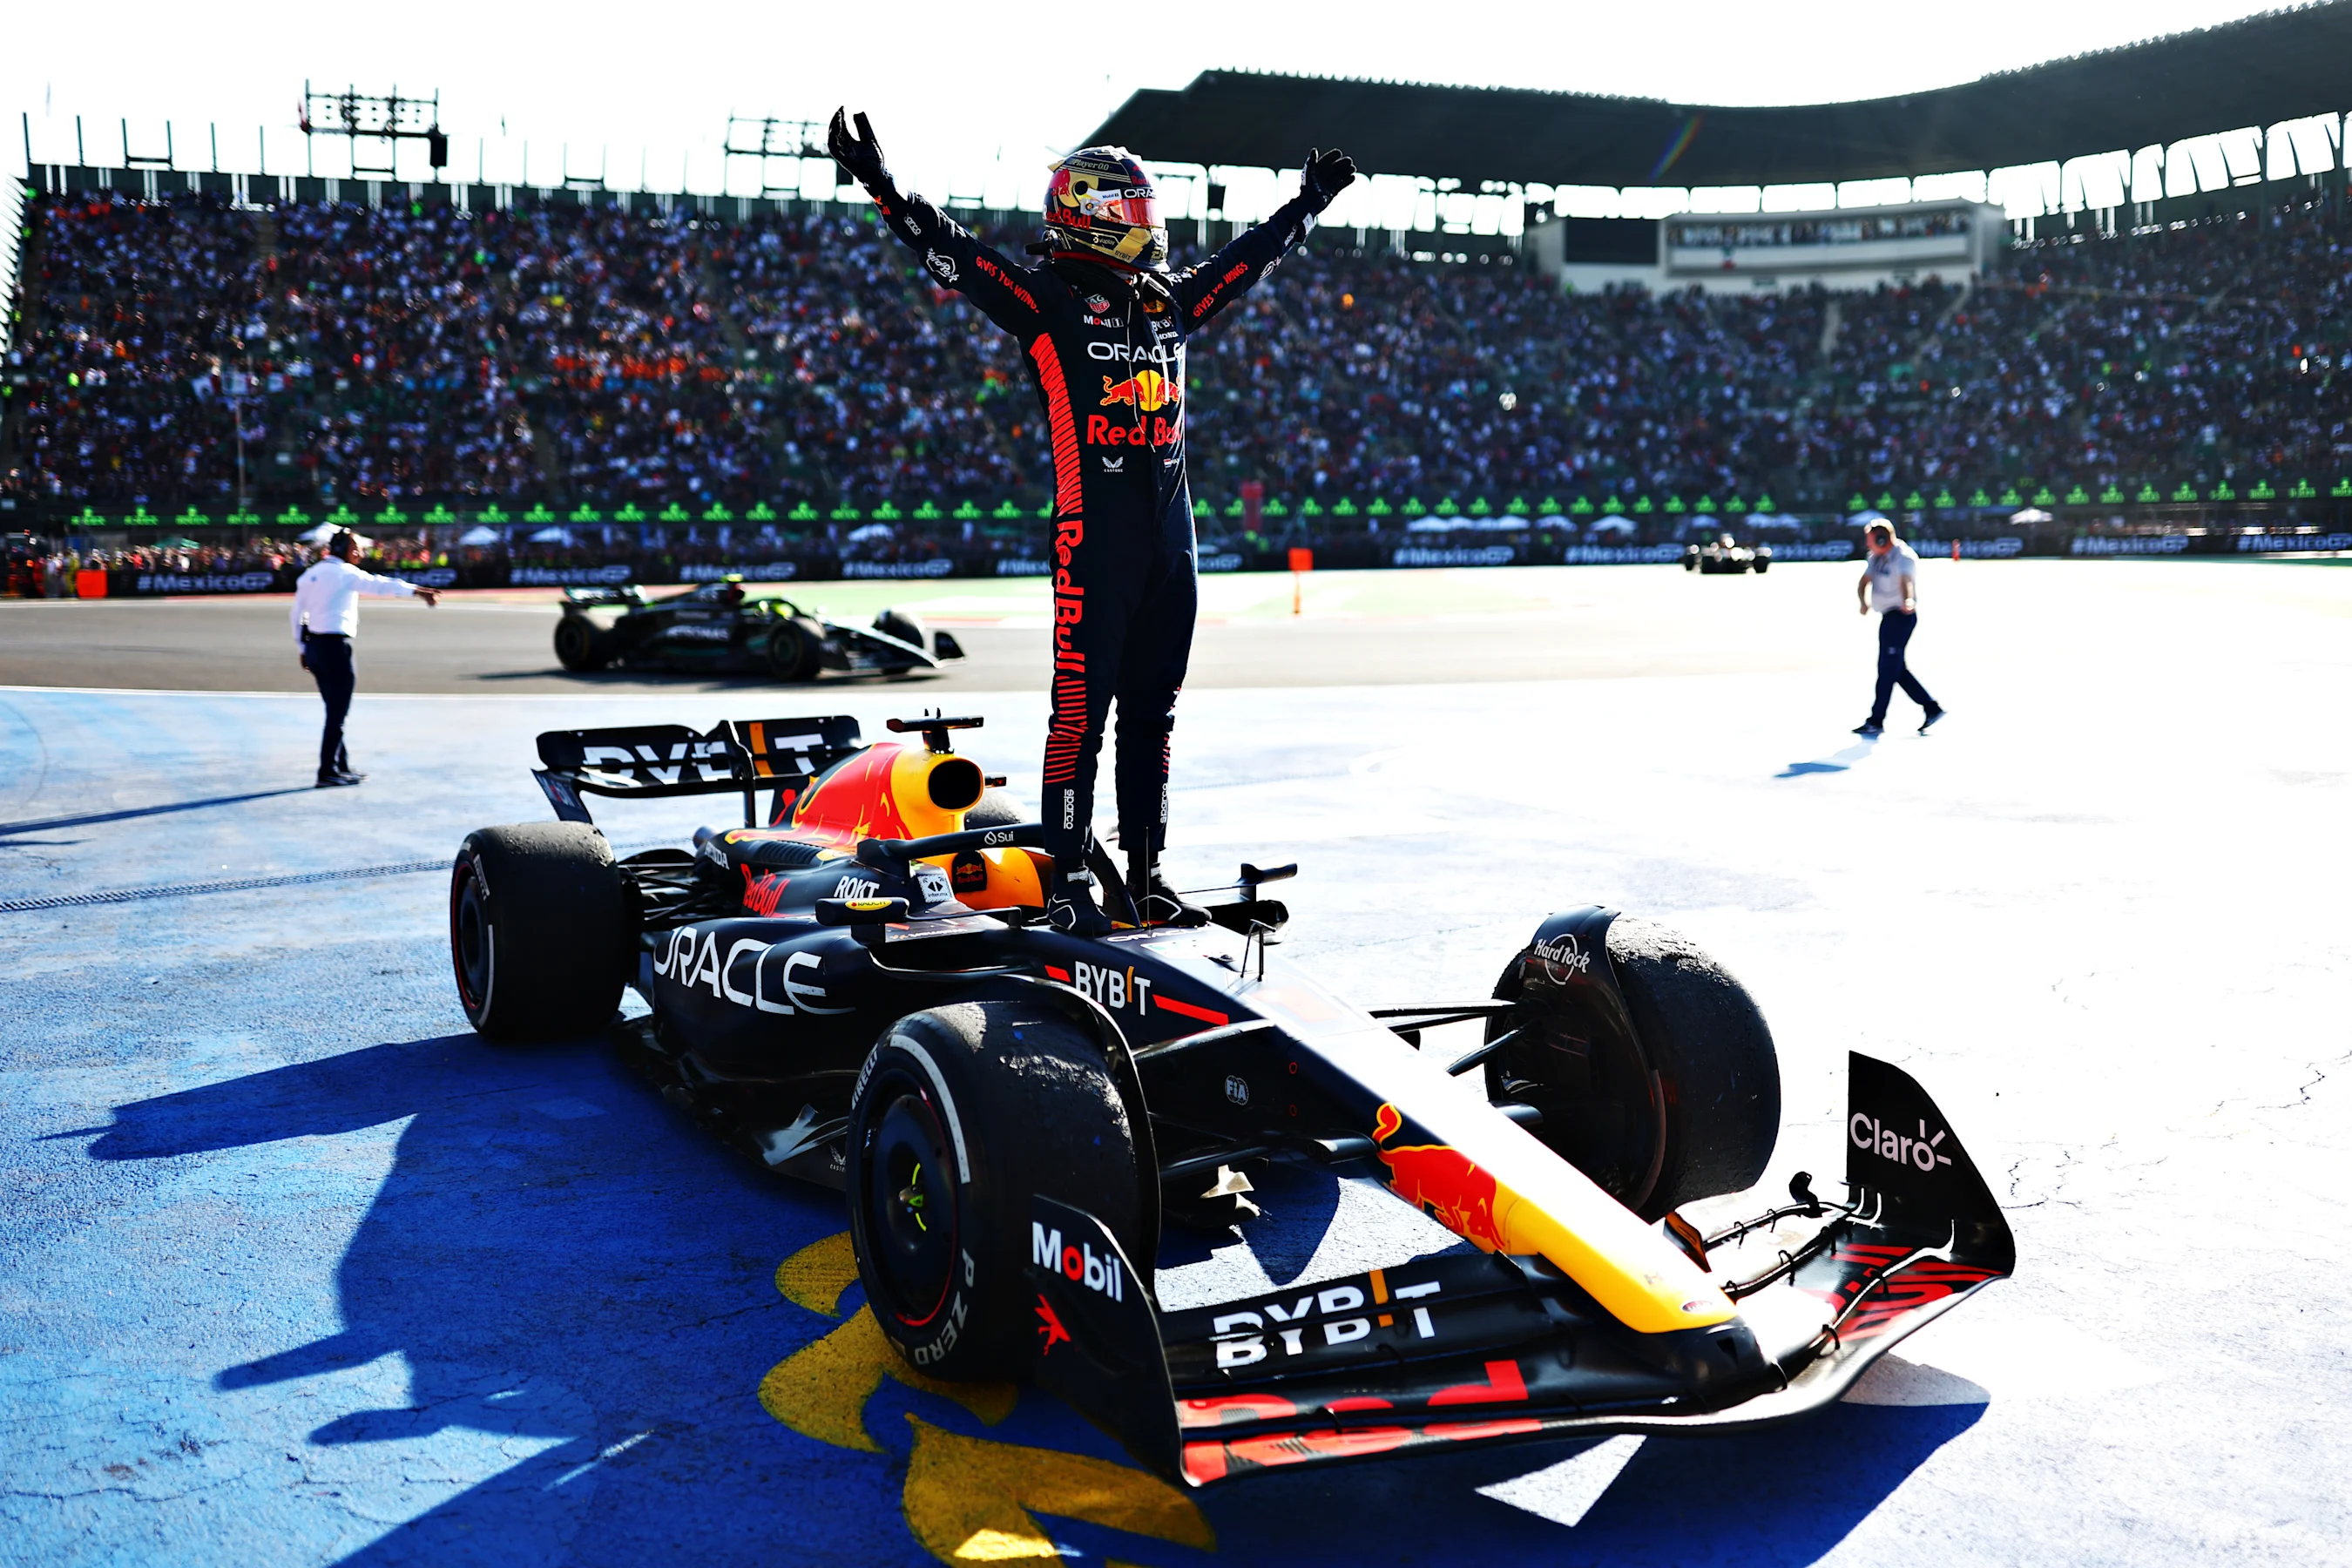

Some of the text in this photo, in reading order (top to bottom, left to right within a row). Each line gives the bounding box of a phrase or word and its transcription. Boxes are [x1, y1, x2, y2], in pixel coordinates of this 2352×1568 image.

[904, 214, 922, 236] arco
[1115, 249, 1132, 260] BYBIT
[976, 255, 998, 278] GIVES
[1013, 287, 1041, 314] WING
[1193, 294, 1214, 318] GIVES
[1222, 261, 1249, 286] WINGS
[1083, 314, 1112, 328] Mobil
[1087, 342, 1182, 364] ORACLE
[1086, 414, 1147, 446] Red
[2071, 535, 2190, 555] #MexicoGP
[2235, 533, 2352, 552] #MexicoGP
[136, 571, 274, 591] #MexicoGP
[1063, 788, 1074, 830] sparco
[1159, 783, 1169, 824] sparco
[997, 830, 1014, 842] Sui
[833, 875, 880, 899] ROKT
[652, 926, 855, 1016] ORACLE
[1534, 938, 1591, 973] Hard Rock
[1075, 960, 1152, 1017] BYBIT
[1849, 1112, 1936, 1173] Claro
[1032, 1220, 1124, 1302] Mobil
[915, 1248, 975, 1364] P ZERO
[1211, 1268, 1442, 1369] BYBIT
